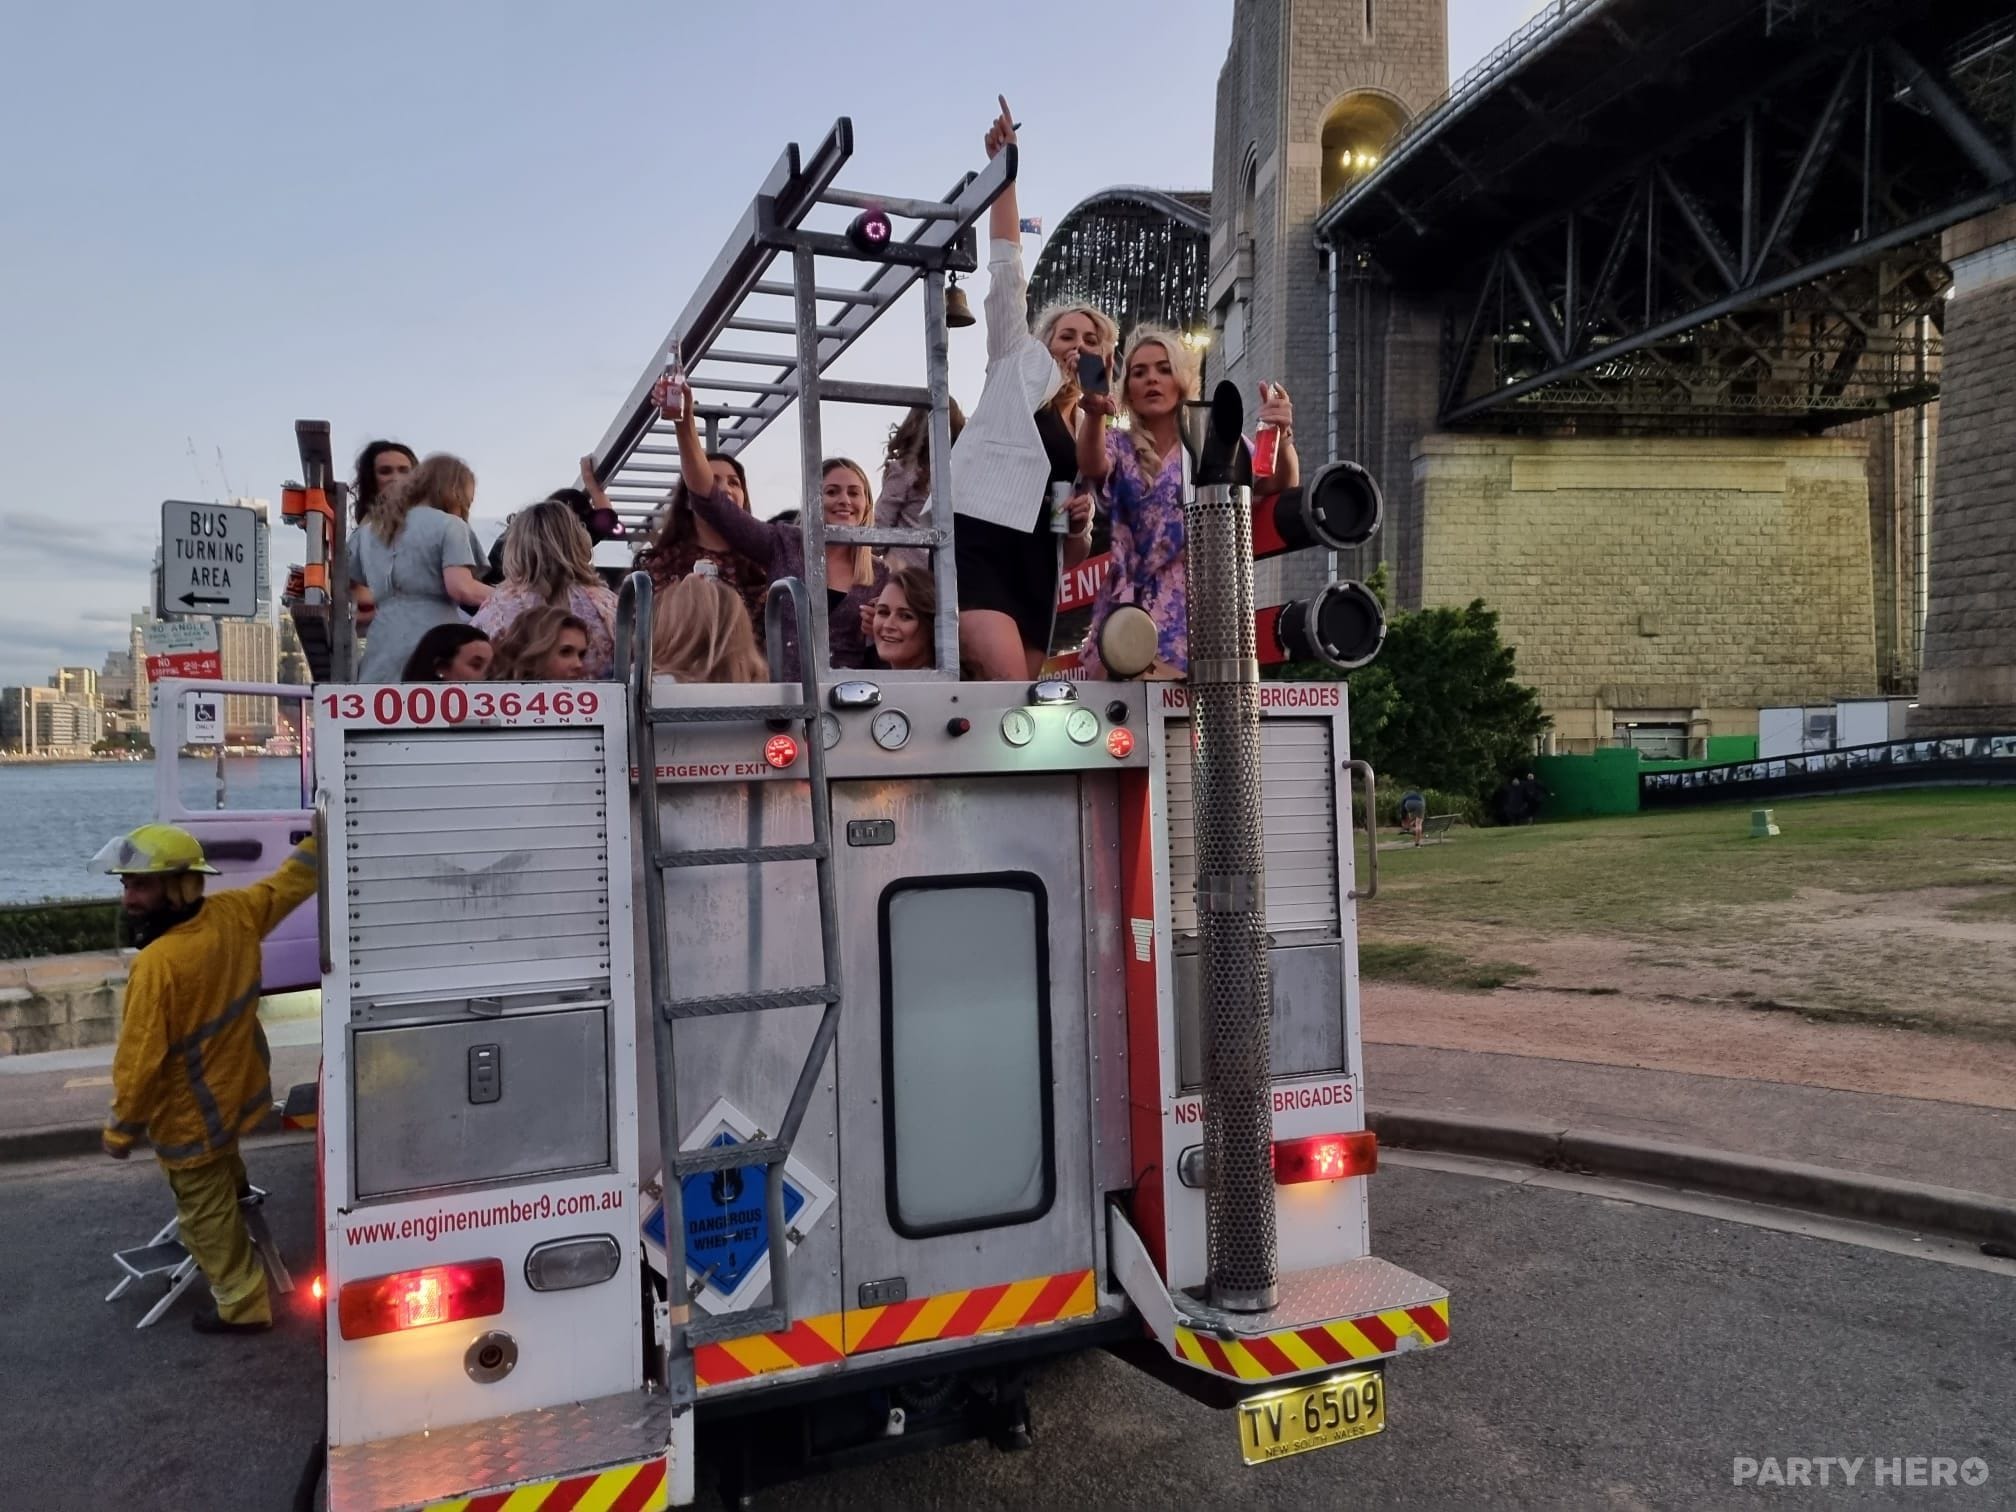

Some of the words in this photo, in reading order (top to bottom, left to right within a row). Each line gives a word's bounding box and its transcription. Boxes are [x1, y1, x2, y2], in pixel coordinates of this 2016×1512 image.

[191, 511, 227, 538] BUS
[176, 538, 244, 564] TURNING
[191, 566, 231, 588] AREA
[1260, 687, 1339, 707] BRIGADES
[631, 765, 730, 778] EERGENCY
[735, 763, 769, 776] EXIT
[1272, 1084, 1353, 1112] BRIGADES
[346, 1190, 623, 1246] www.enginenumber9.com.au
[1265, 1442, 1289, 1457] NEW
[1294, 1433, 1328, 1450] SOUTH
[1334, 1423, 1366, 1440] WALES
